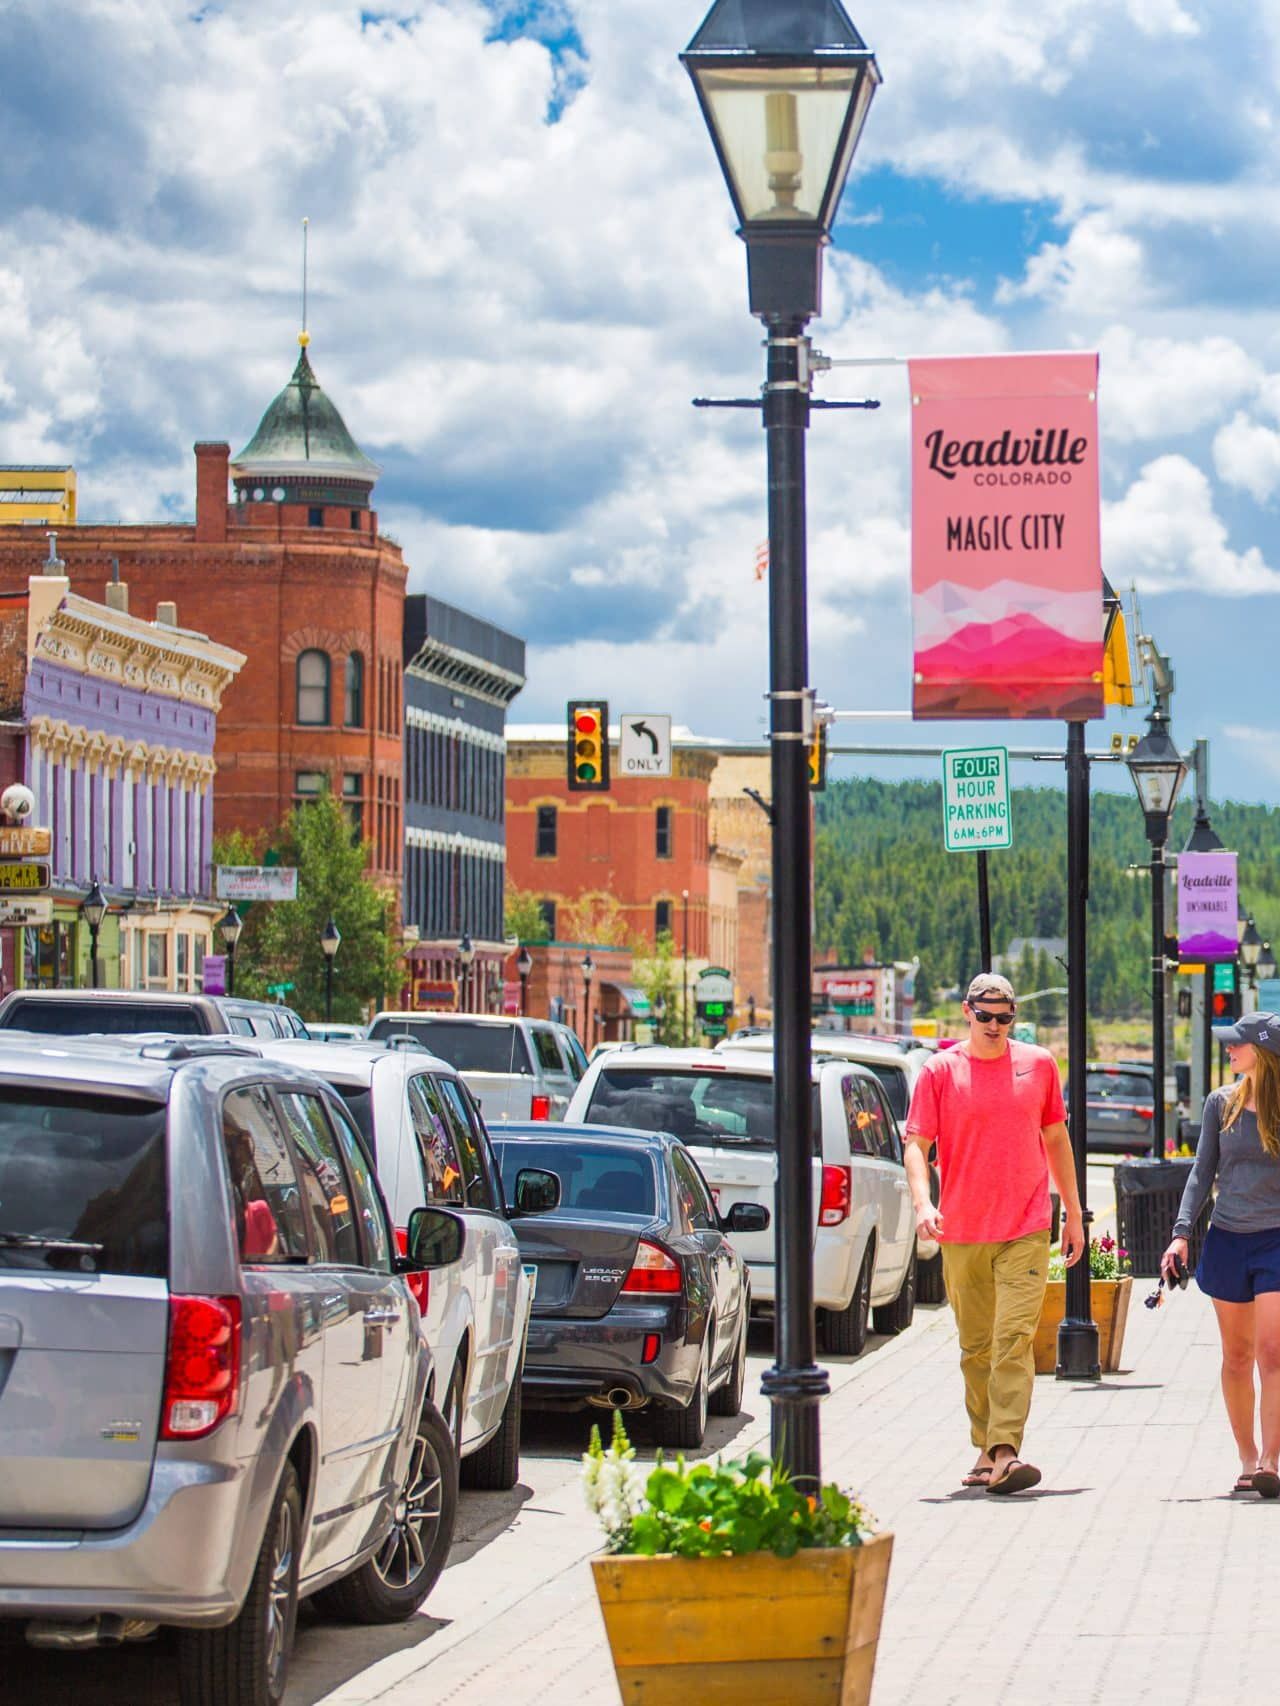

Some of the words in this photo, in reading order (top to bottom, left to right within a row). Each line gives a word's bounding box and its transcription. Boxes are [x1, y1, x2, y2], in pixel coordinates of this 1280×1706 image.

[924, 428, 1088, 480] Leadville
[973, 471, 1072, 486] COLORADO
[946, 514, 1013, 551] MAGIC
[1020, 513, 1065, 550] CITY
[627, 758, 663, 771] ONLY
[954, 758, 998, 777] FOUR
[957, 780, 996, 798] HOUR
[948, 802, 1006, 821] PARKING
[1182, 874, 1233, 891] Leadville
[1186, 901, 1228, 913] UNSINKABLE
